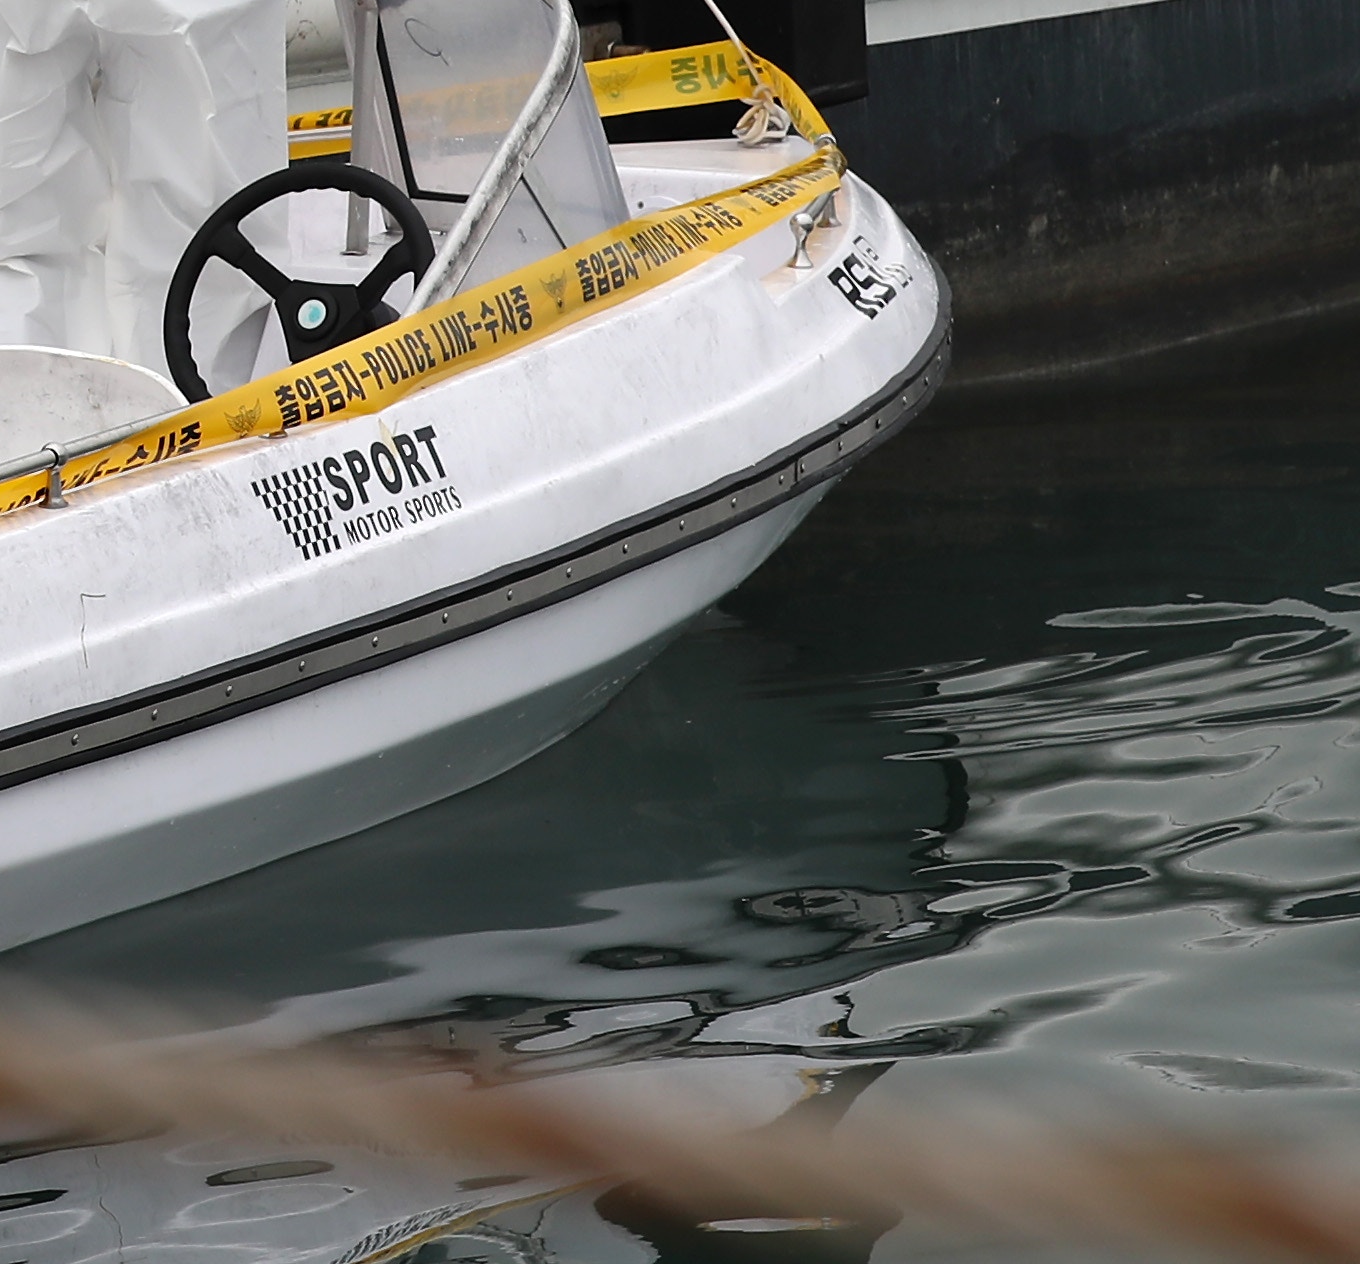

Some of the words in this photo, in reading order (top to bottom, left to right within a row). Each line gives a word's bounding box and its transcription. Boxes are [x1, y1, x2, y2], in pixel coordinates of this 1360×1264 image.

[322, 424, 448, 512] SPORT
[343, 505, 404, 547] MOTOR
[404, 485, 463, 525] SPORTS
